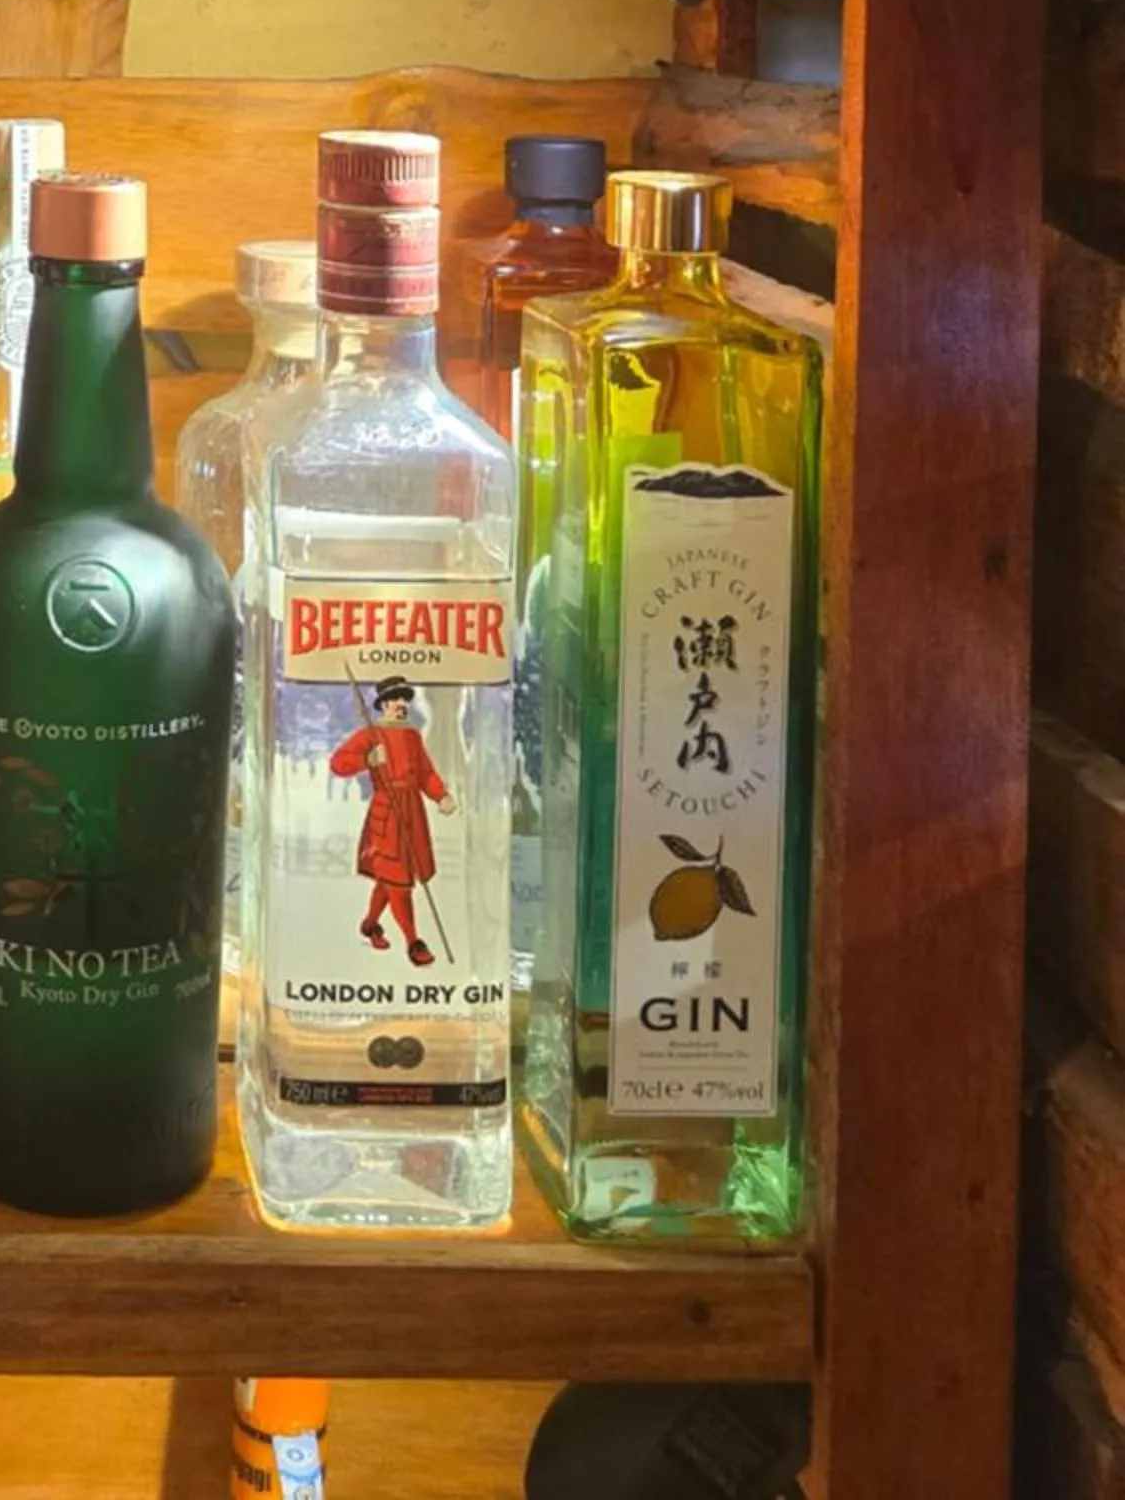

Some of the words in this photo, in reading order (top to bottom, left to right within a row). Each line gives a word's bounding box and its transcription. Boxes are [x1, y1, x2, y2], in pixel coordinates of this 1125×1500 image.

[640, 569, 723, 619] CRAFT
[728, 578, 772, 621] GIN
[291, 596, 506, 659] BEEFEATER
[358, 648, 443, 665] LONDON
[637, 767, 767, 816] SETOUCHI
[45, 948, 105, 980] NO
[111, 939, 184, 978] TEA
[19, 979, 77, 1005] Kyoto
[82, 985, 121, 1007] Dry
[125, 981, 161, 1000] Gin
[285, 979, 394, 1004] LONDON
[405, 984, 457, 1005] DRY
[463, 982, 505, 1004] GIN
[639, 995, 750, 1033] GIN
